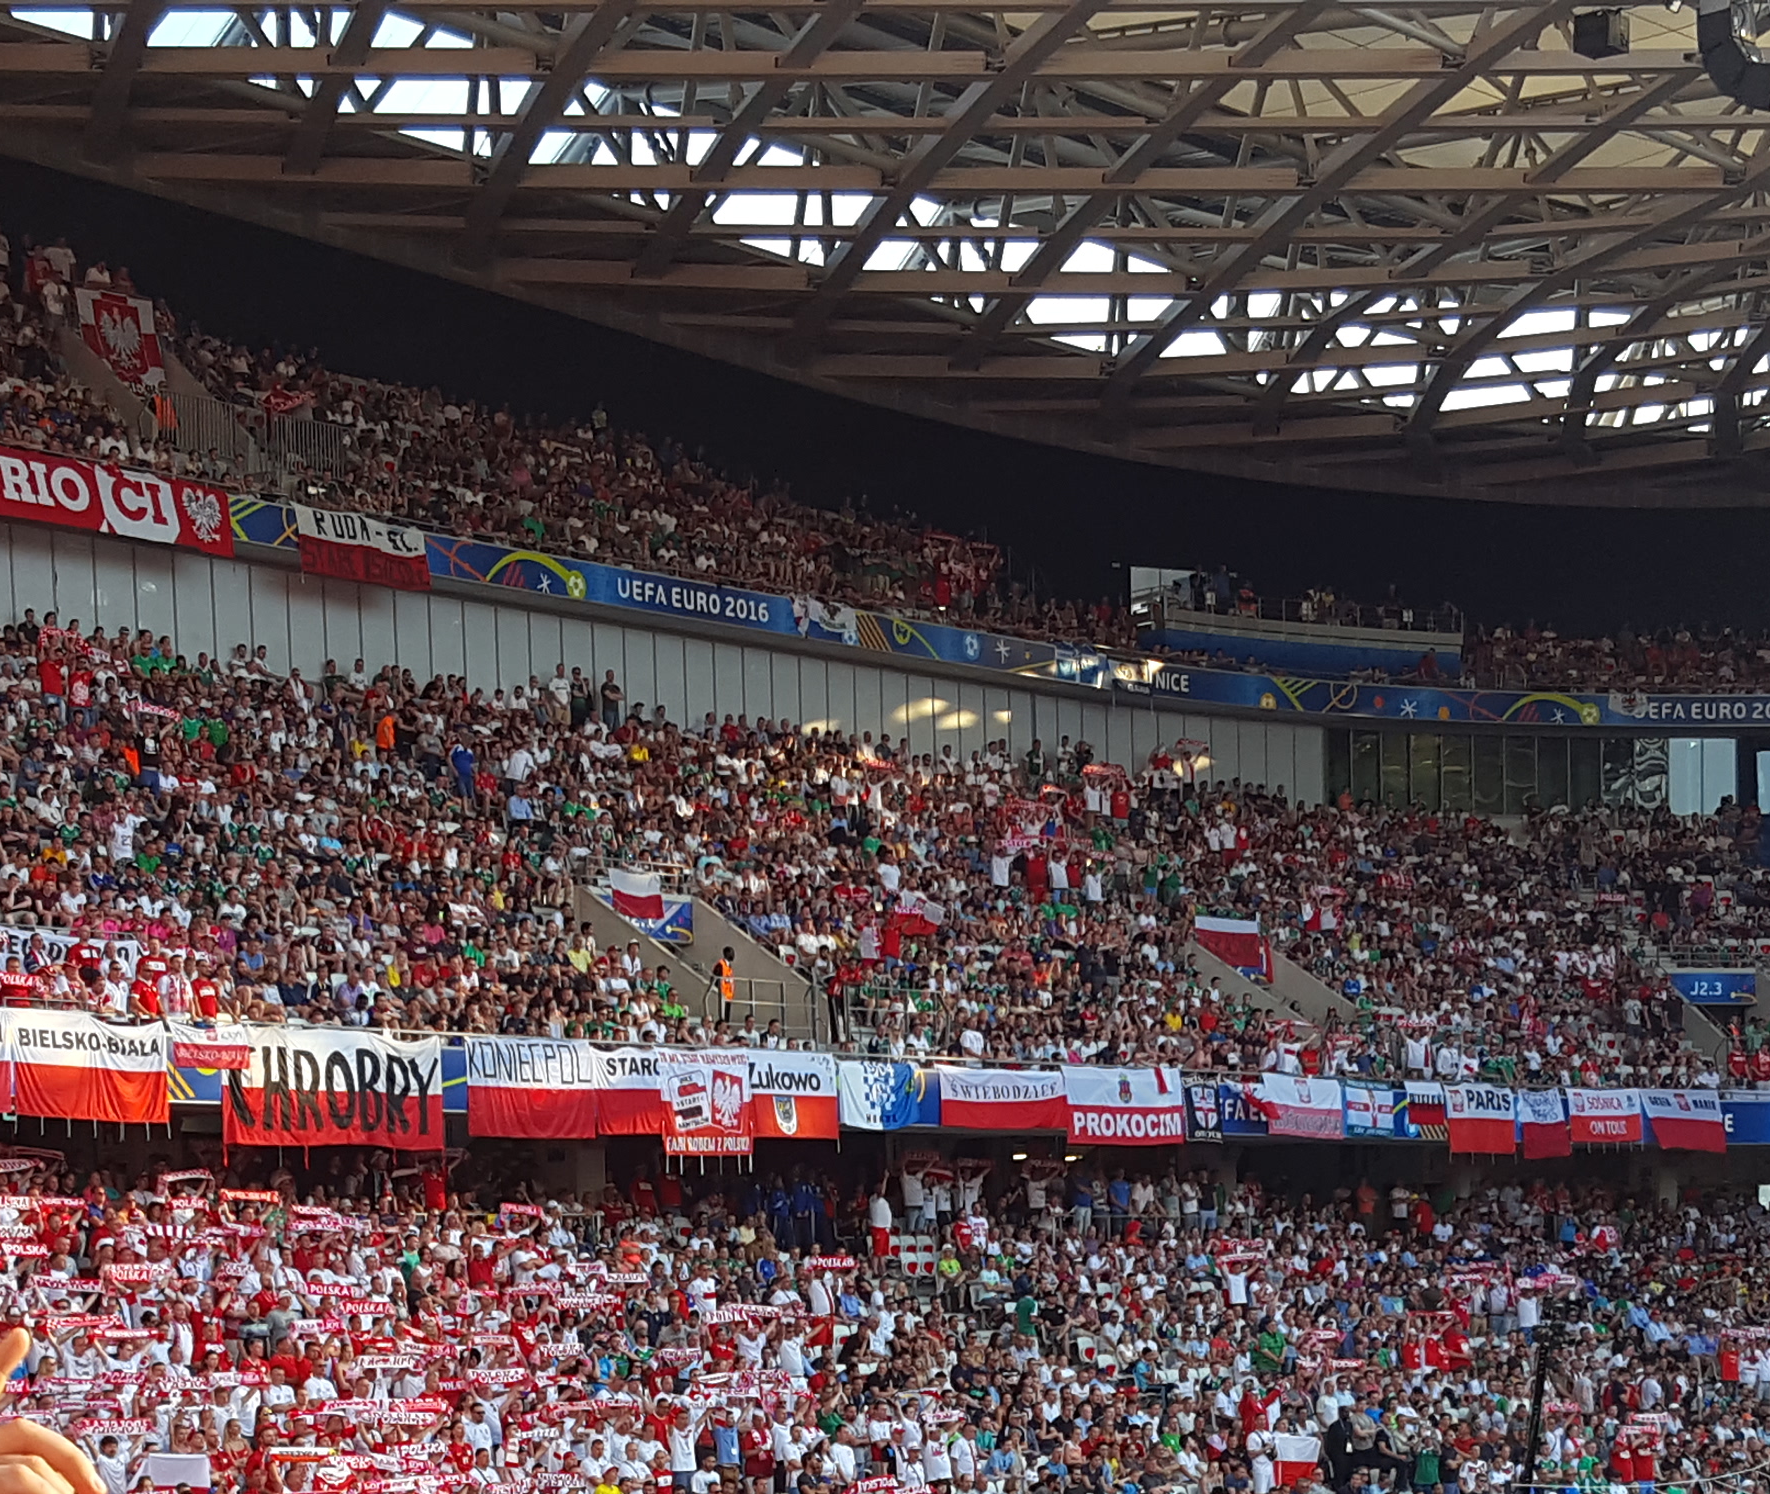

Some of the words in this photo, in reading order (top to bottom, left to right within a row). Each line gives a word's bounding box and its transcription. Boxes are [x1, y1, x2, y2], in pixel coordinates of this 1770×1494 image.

[617, 576, 667, 605] UEFA
[671, 587, 721, 614] EURO
[724, 596, 770, 622] 2016
[1155, 671, 1190, 693] NICE
[1690, 701, 1748, 720] EURO
[1689, 981, 1723, 997] J2.3
[18, 1028, 162, 1058] BIELSKO-BIAŁA
[467, 1041, 592, 1086] KONIECPOL
[1466, 1088, 1512, 1113] PARIS
[1072, 1112, 1182, 1137] PROKOCIM
